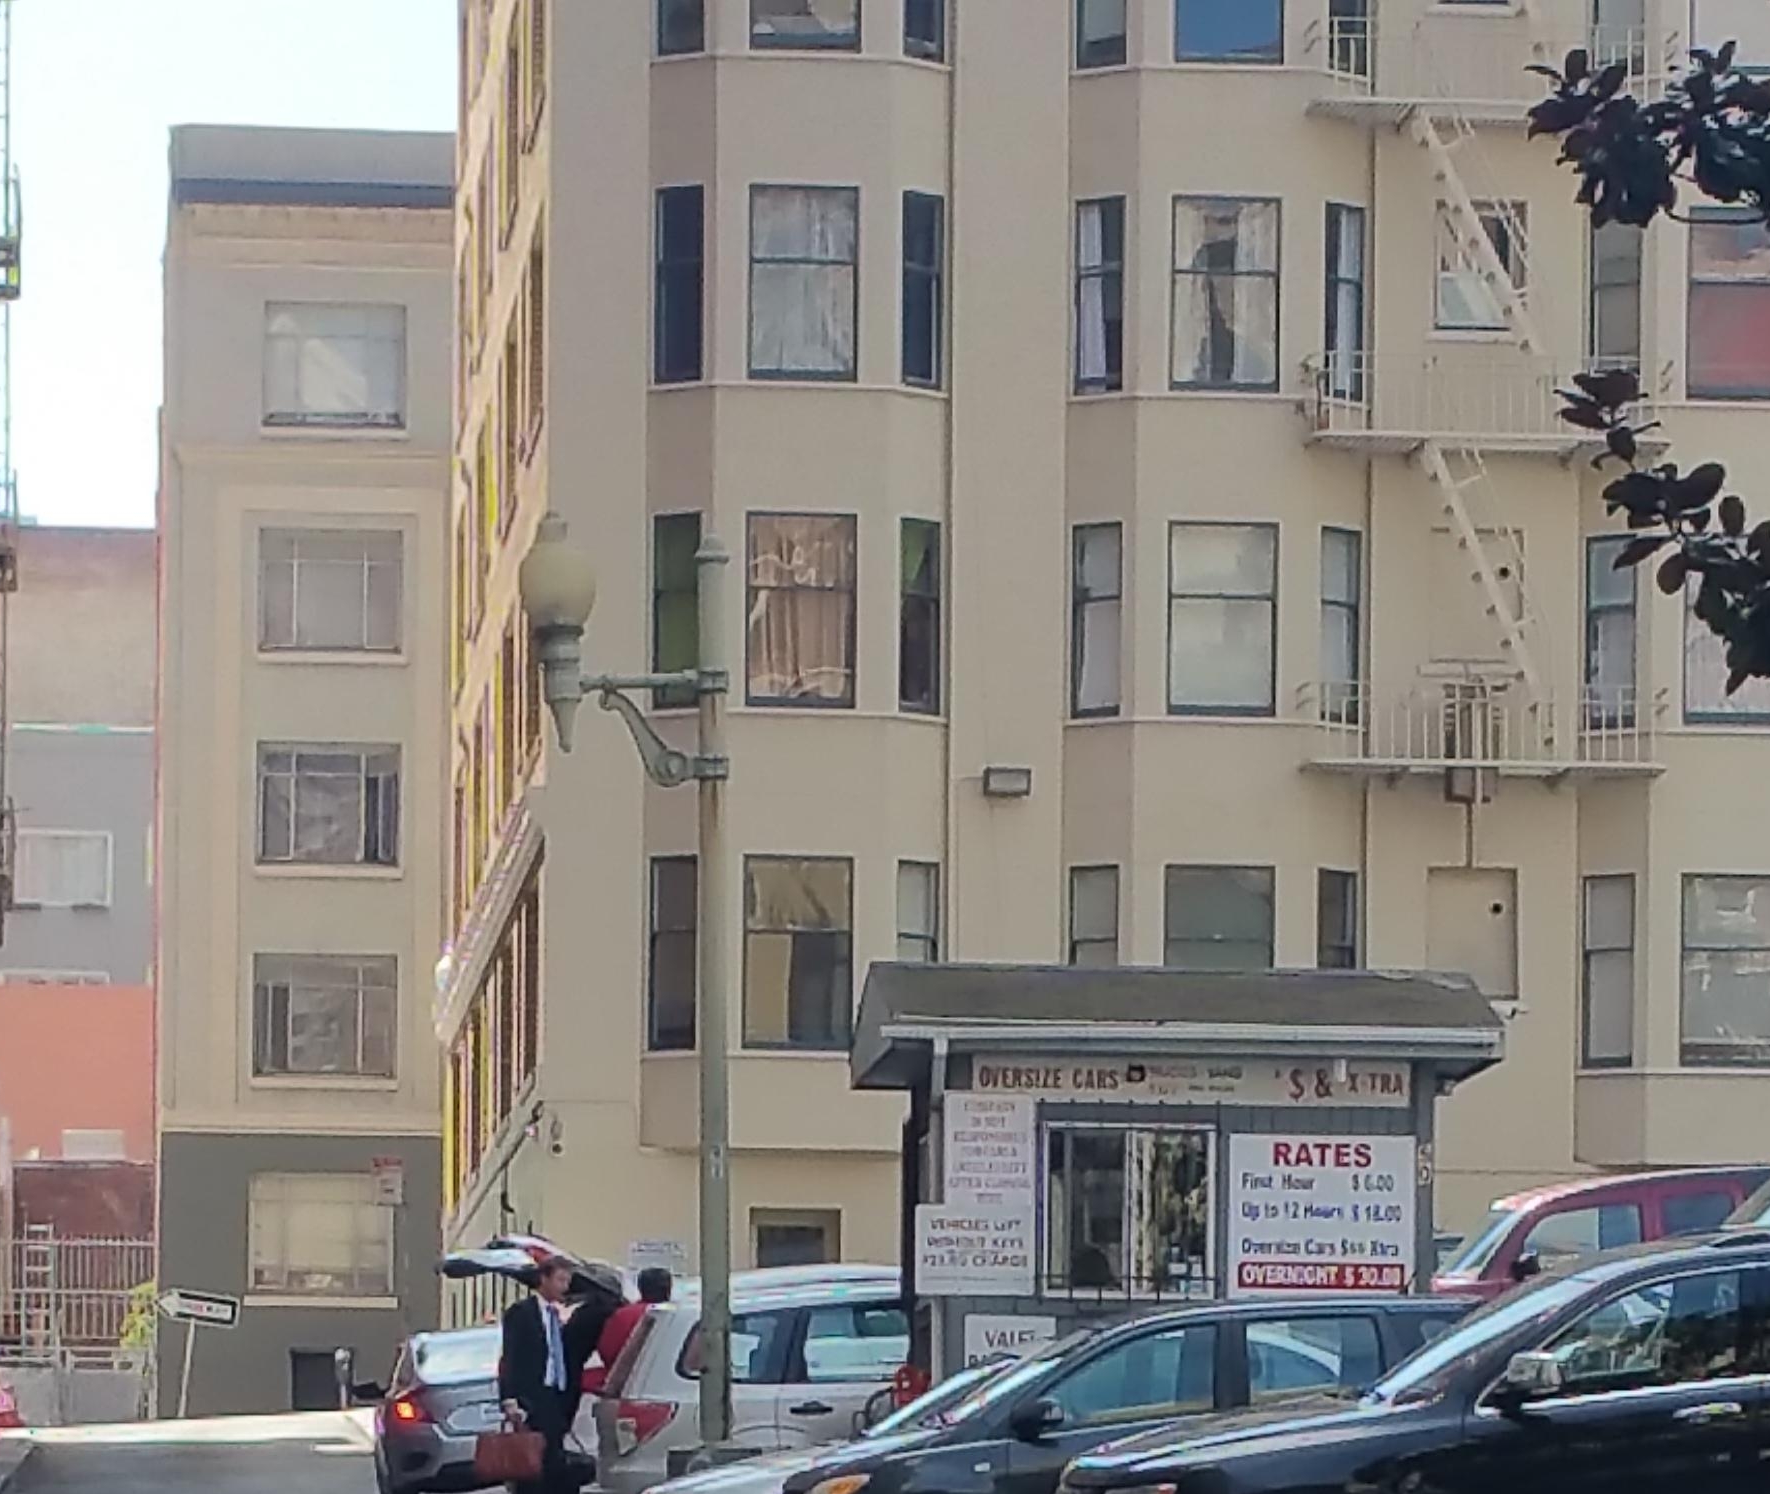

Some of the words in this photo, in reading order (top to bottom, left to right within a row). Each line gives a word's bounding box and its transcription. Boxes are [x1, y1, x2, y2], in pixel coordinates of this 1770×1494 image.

[979, 1066, 1061, 1089] OVERSIZE
[1072, 1067, 1119, 1090] CARS
[1273, 1142, 1372, 1168] RATES
[1242, 1172, 1273, 1190] First
[1281, 1174, 1315, 1191] Hour
[1242, 1202, 1260, 1221] Up
[1264, 1203, 1278, 1219] to
[1284, 1202, 1299, 1219] 12
[1305, 1238, 1335, 1255] Cars
[1242, 1264, 1339, 1285] OVERNIGHT
